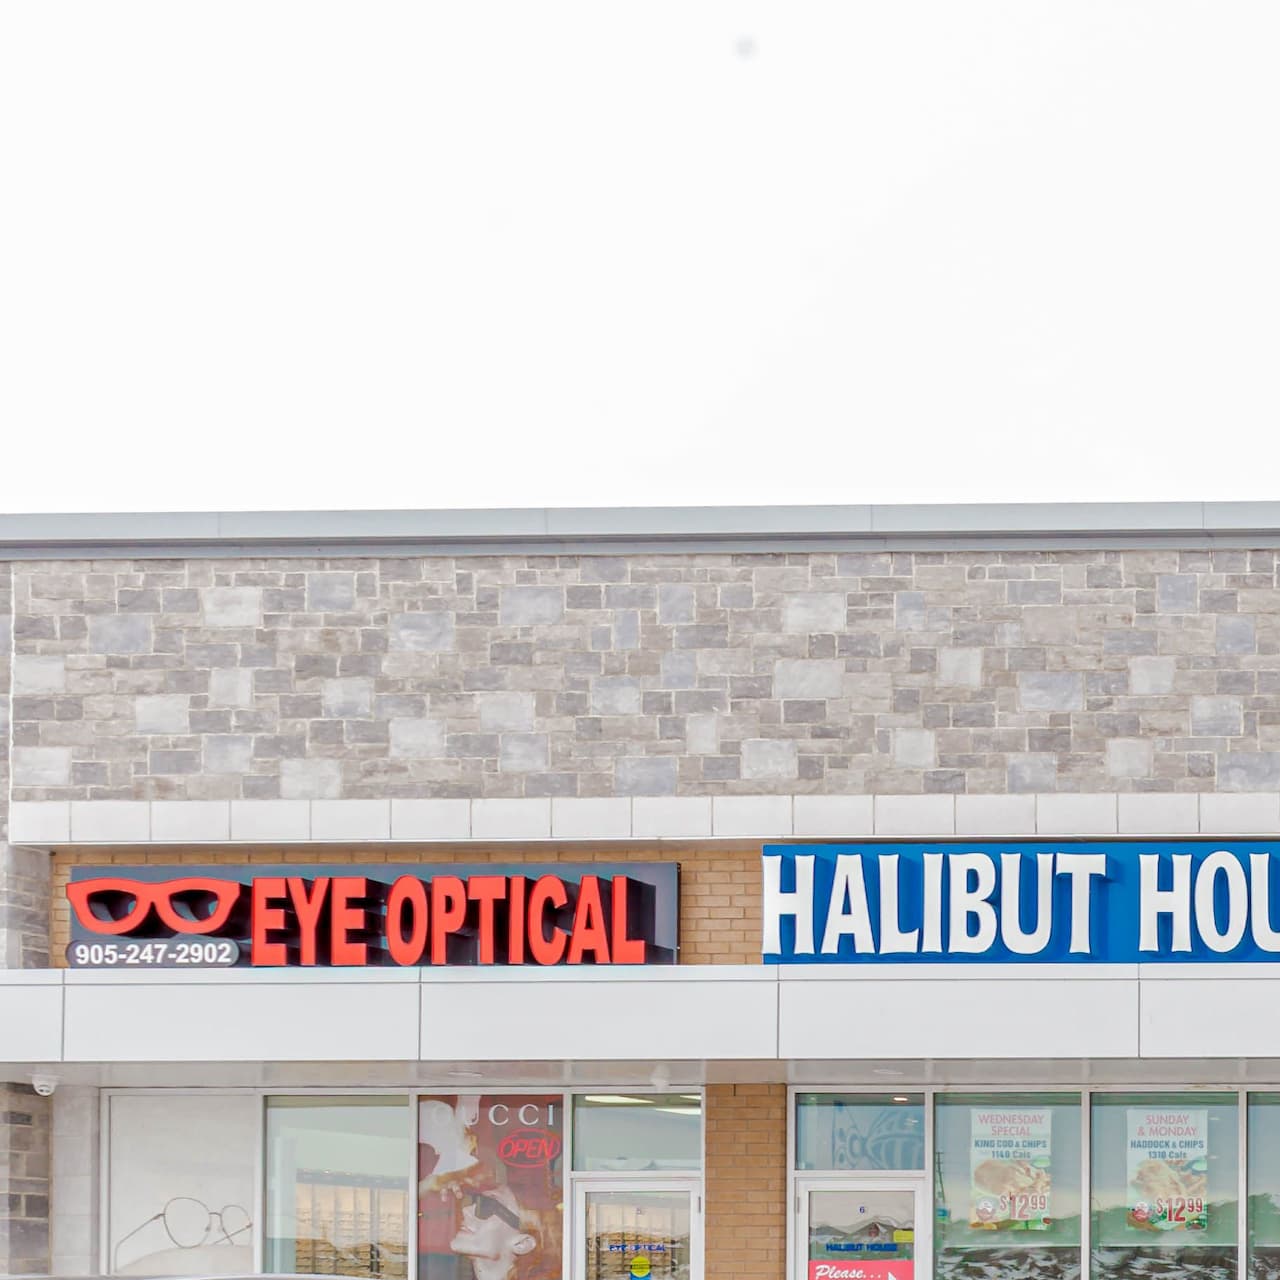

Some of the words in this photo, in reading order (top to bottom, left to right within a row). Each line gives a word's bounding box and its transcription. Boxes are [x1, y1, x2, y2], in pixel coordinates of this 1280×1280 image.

[761, 850, 1106, 955] HALIBUT
[252, 875, 369, 966] EYE
[386, 874, 646, 966] OPTICAL
[75, 941, 232, 965] 905-247-2902
[978, 1114, 1045, 1125] WEDNESDAY
[1145, 1114, 1190, 1125] SUNDAY
[991, 1126, 1031, 1137] SPECIAL
[1137, 1126, 1145, 1137] &
[1149, 1126, 1197, 1137] MONDAY
[500, 1137, 556, 1159] OPEN
[974, 1139, 995, 1148] KING
[1022, 1139, 1047, 1148] CHIPS
[1130, 1139, 1170, 1149] HADDOCK
[1178, 1139, 1204, 1149] CHIPS
[859, 1206, 865, 1214] 6
